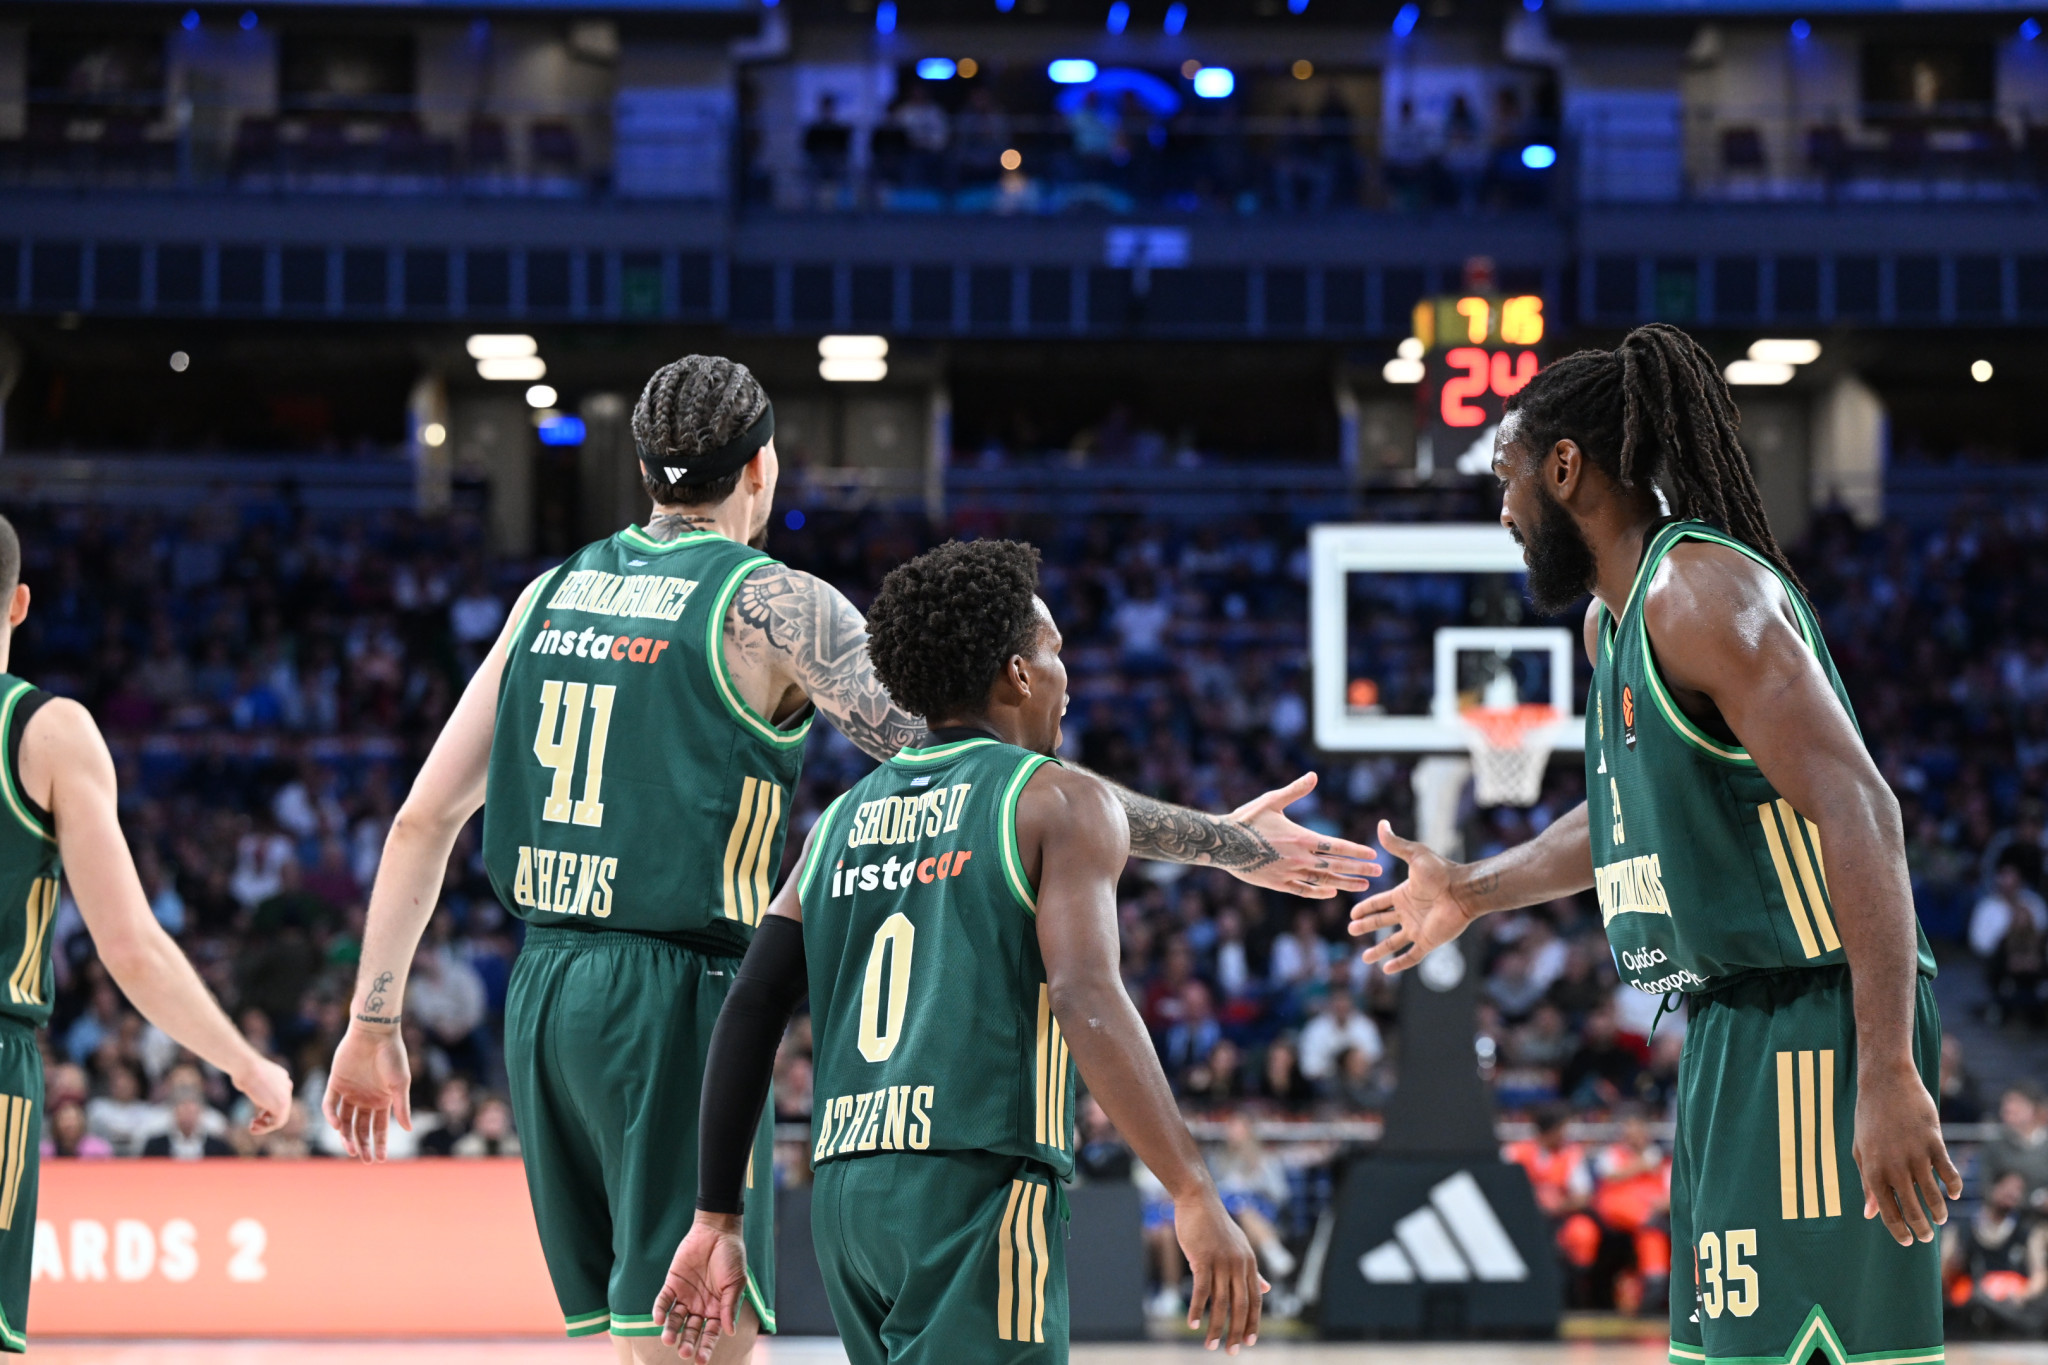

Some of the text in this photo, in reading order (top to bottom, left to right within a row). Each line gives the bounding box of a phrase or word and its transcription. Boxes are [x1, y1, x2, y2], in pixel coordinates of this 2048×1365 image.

[1441, 347, 1539, 428] 24
[530, 619, 669, 664] instacar
[533, 679, 617, 828] 41
[848, 787, 948, 849] SHORTS
[831, 850, 973, 898] instacar
[857, 911, 916, 1063] 0
[813, 1085, 935, 1163] ATHENS
[226, 1216, 268, 1283] 2
[1699, 1228, 1760, 1319] 35
